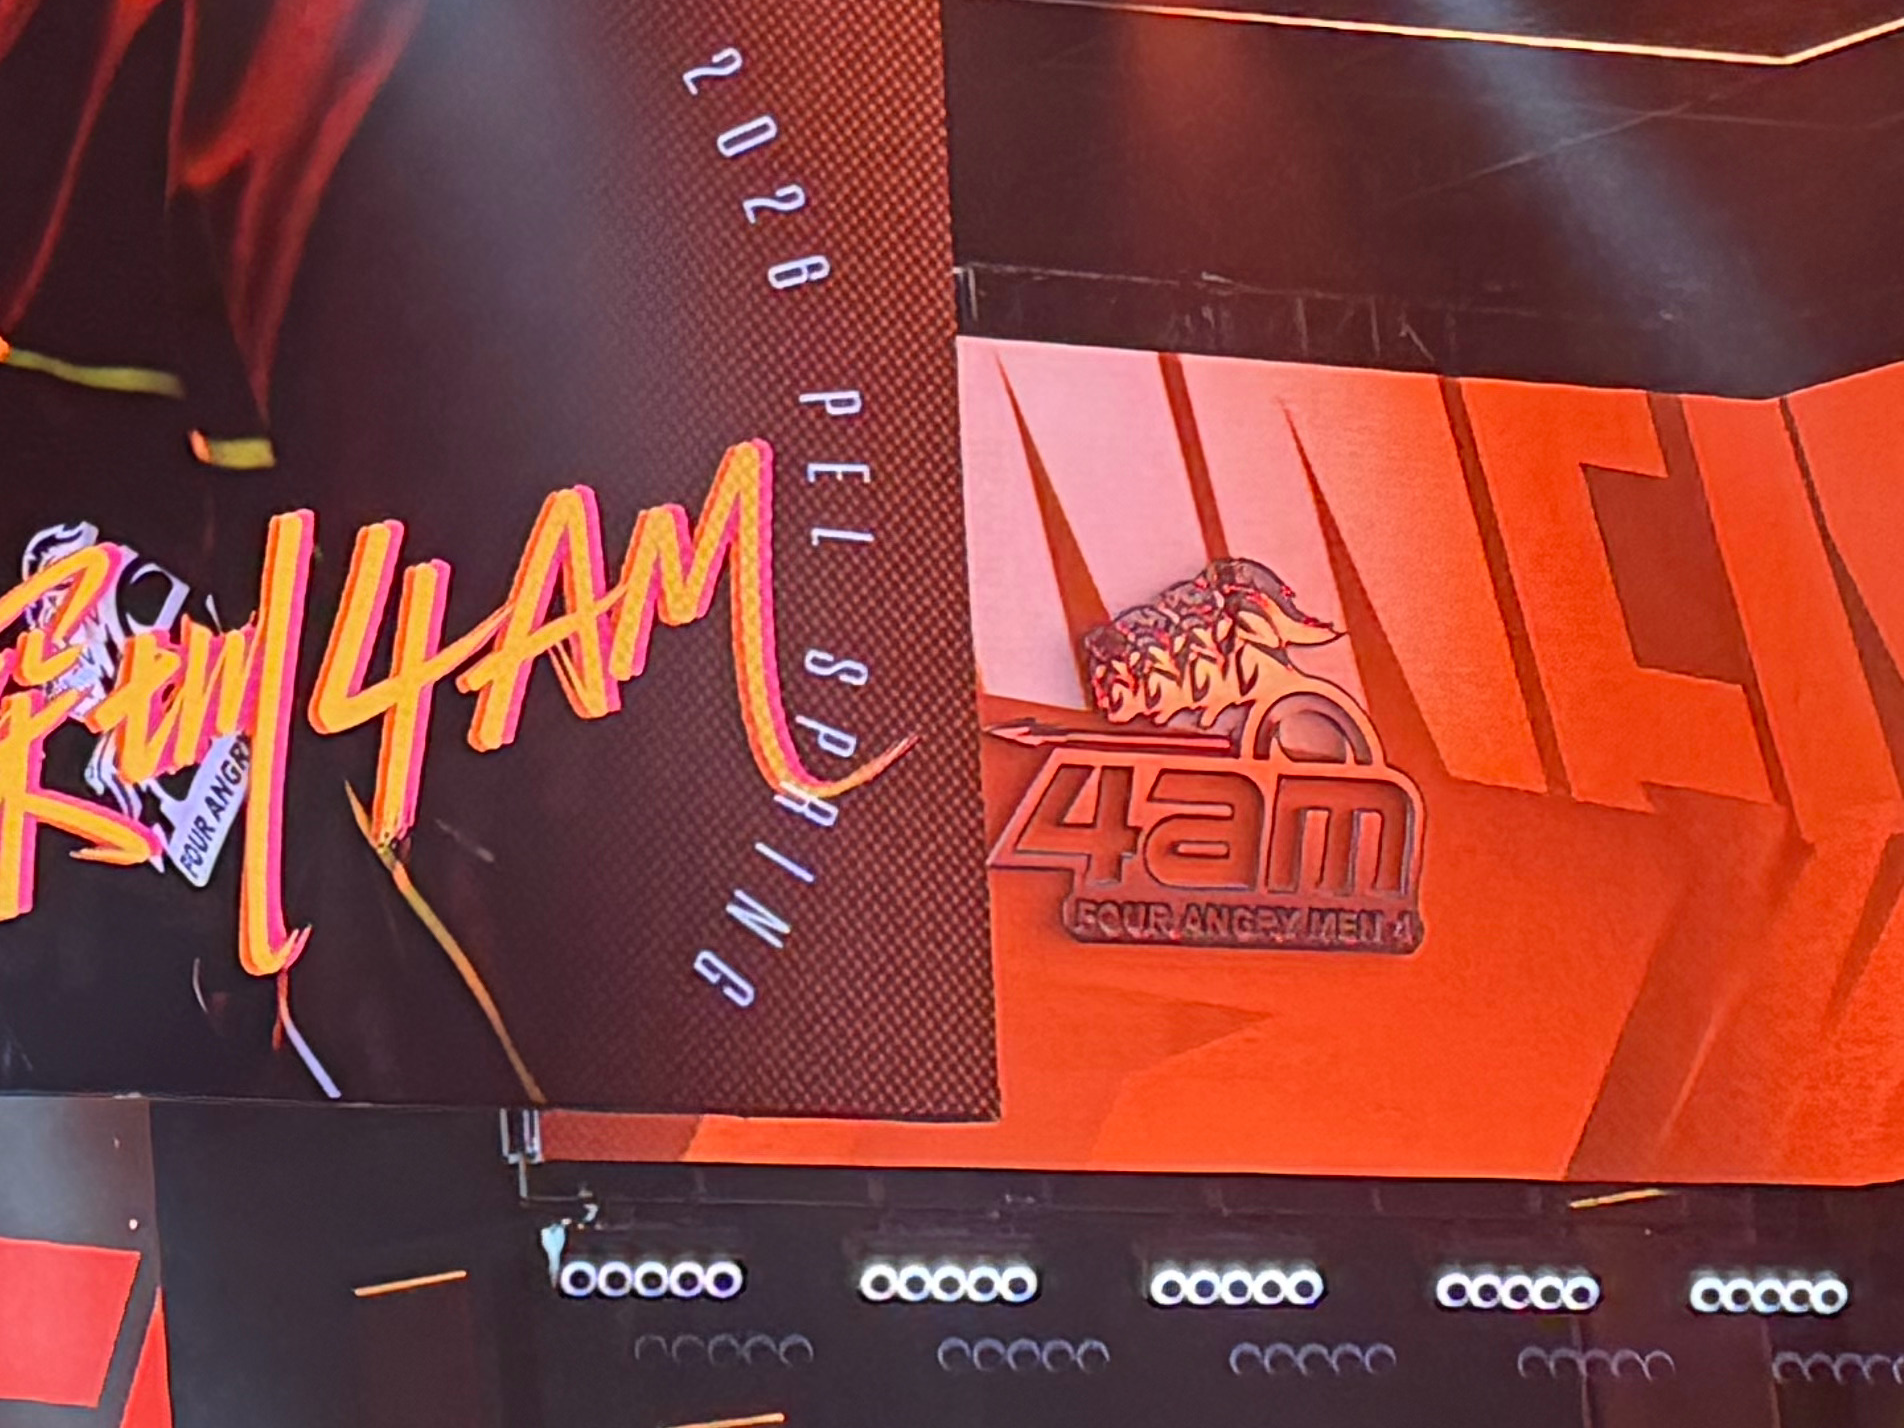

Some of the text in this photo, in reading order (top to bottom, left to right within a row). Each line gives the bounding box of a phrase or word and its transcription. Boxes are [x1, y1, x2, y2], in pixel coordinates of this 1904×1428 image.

[682, 47, 875, 1008] 2026 PEL SPRING
[1075, 900, 1176, 939] FOUR
[1307, 907, 1384, 944] MEN
